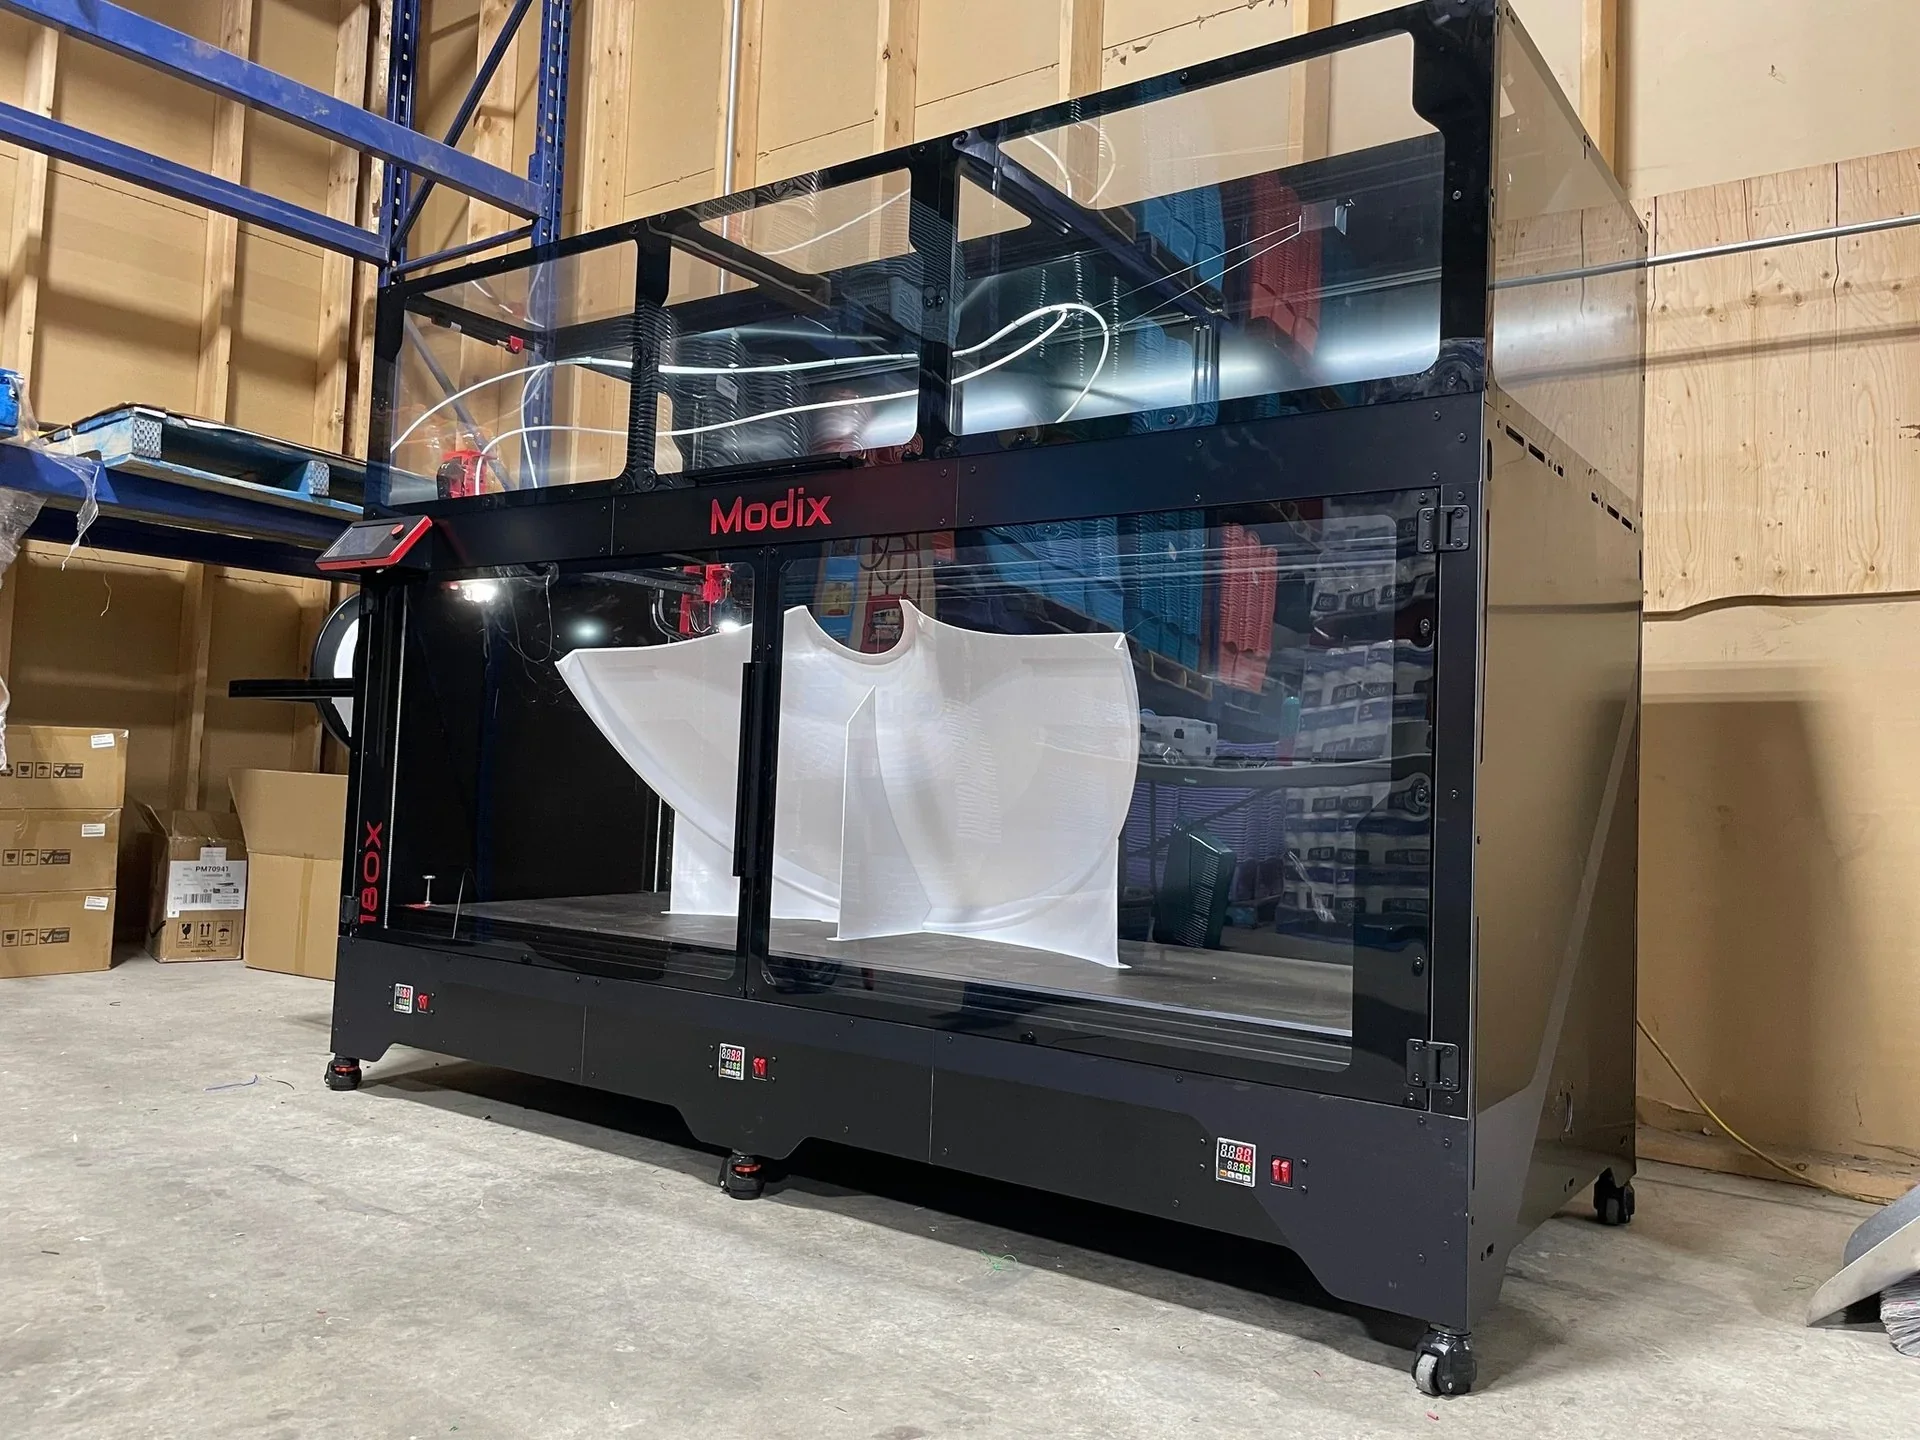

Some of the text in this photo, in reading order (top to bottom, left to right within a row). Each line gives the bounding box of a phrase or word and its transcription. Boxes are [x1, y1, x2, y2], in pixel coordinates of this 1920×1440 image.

[711, 487, 832, 534] Modix
[195, 865, 229, 873] PM70941
[360, 821, 383, 924] 180X
